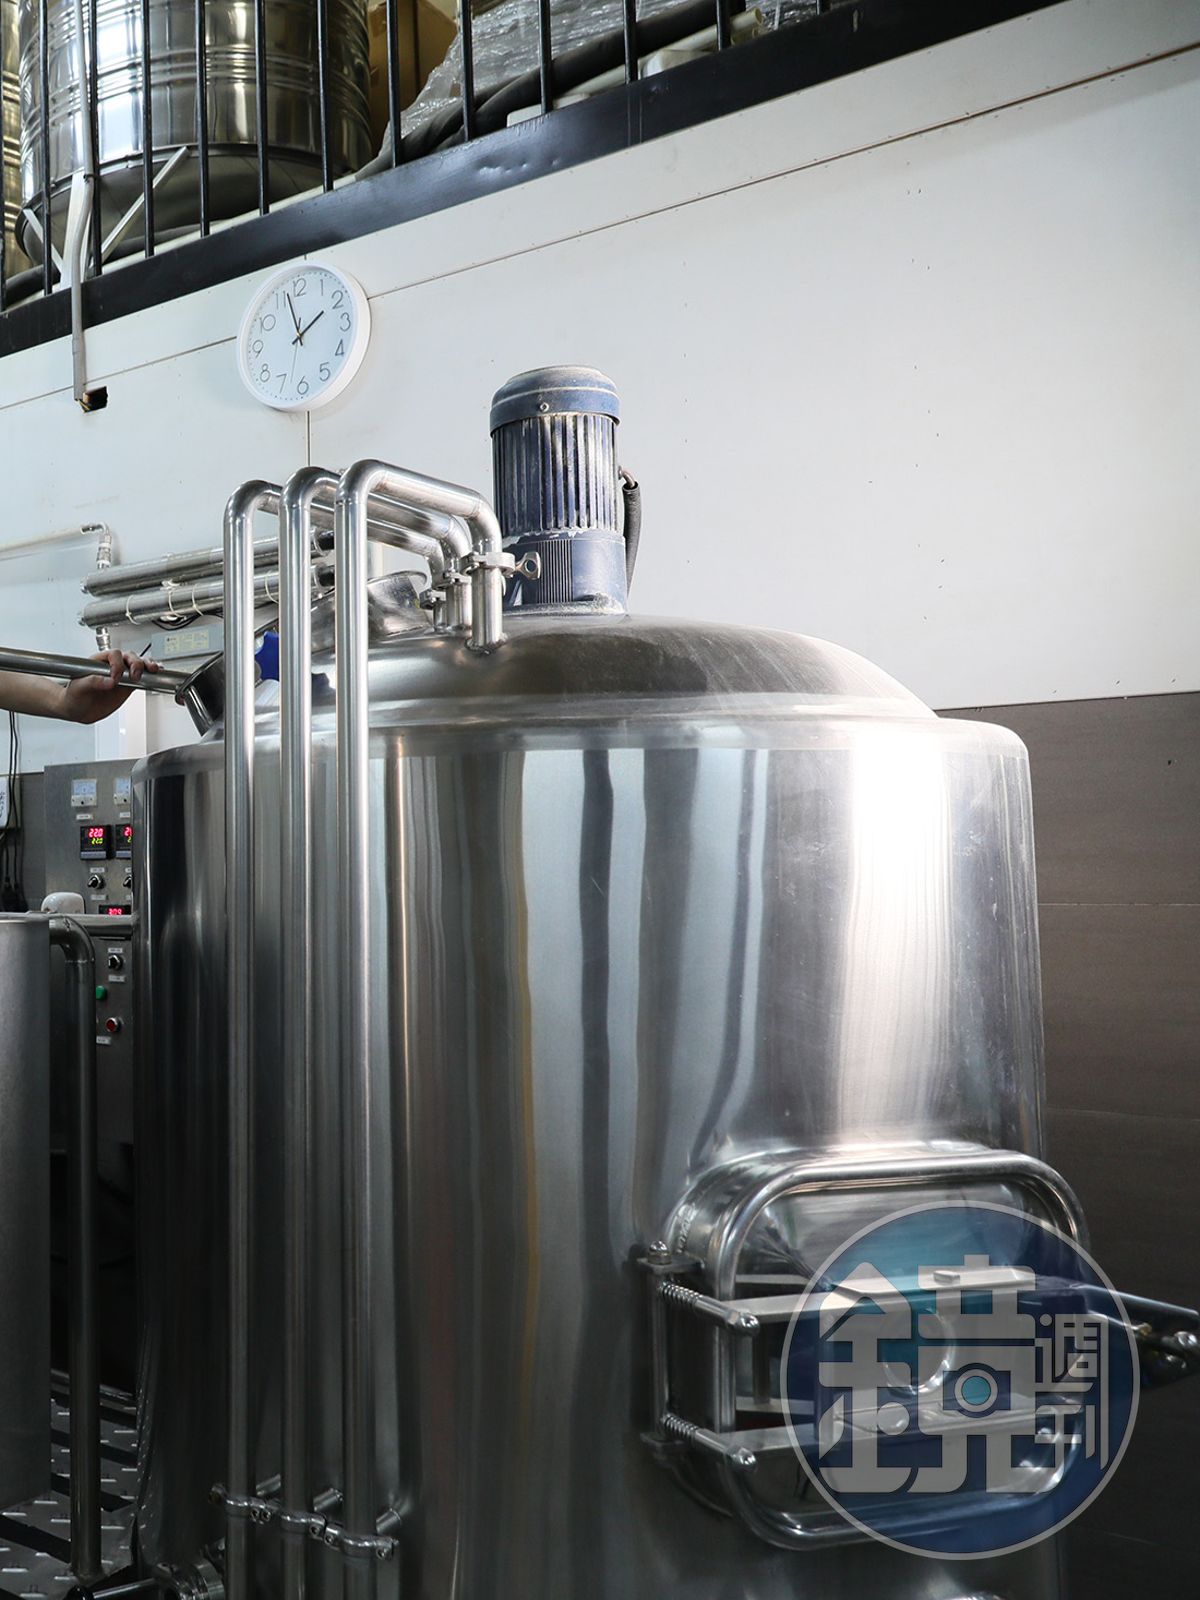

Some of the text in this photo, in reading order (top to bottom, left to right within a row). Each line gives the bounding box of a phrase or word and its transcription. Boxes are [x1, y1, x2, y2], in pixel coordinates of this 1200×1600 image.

[292, 277, 307, 298] 12
[275, 290, 287, 310] 11
[331, 290, 344, 310] 2
[259, 313, 277, 334] 10
[340, 312, 351, 332] 3
[252, 339, 264, 359] 9
[334, 339, 345, 357] 4
[259, 363, 271, 383] 8
[319, 362, 331, 382] 5
[276, 373, 287, 394] 7
[296, 375, 310, 396] 6
